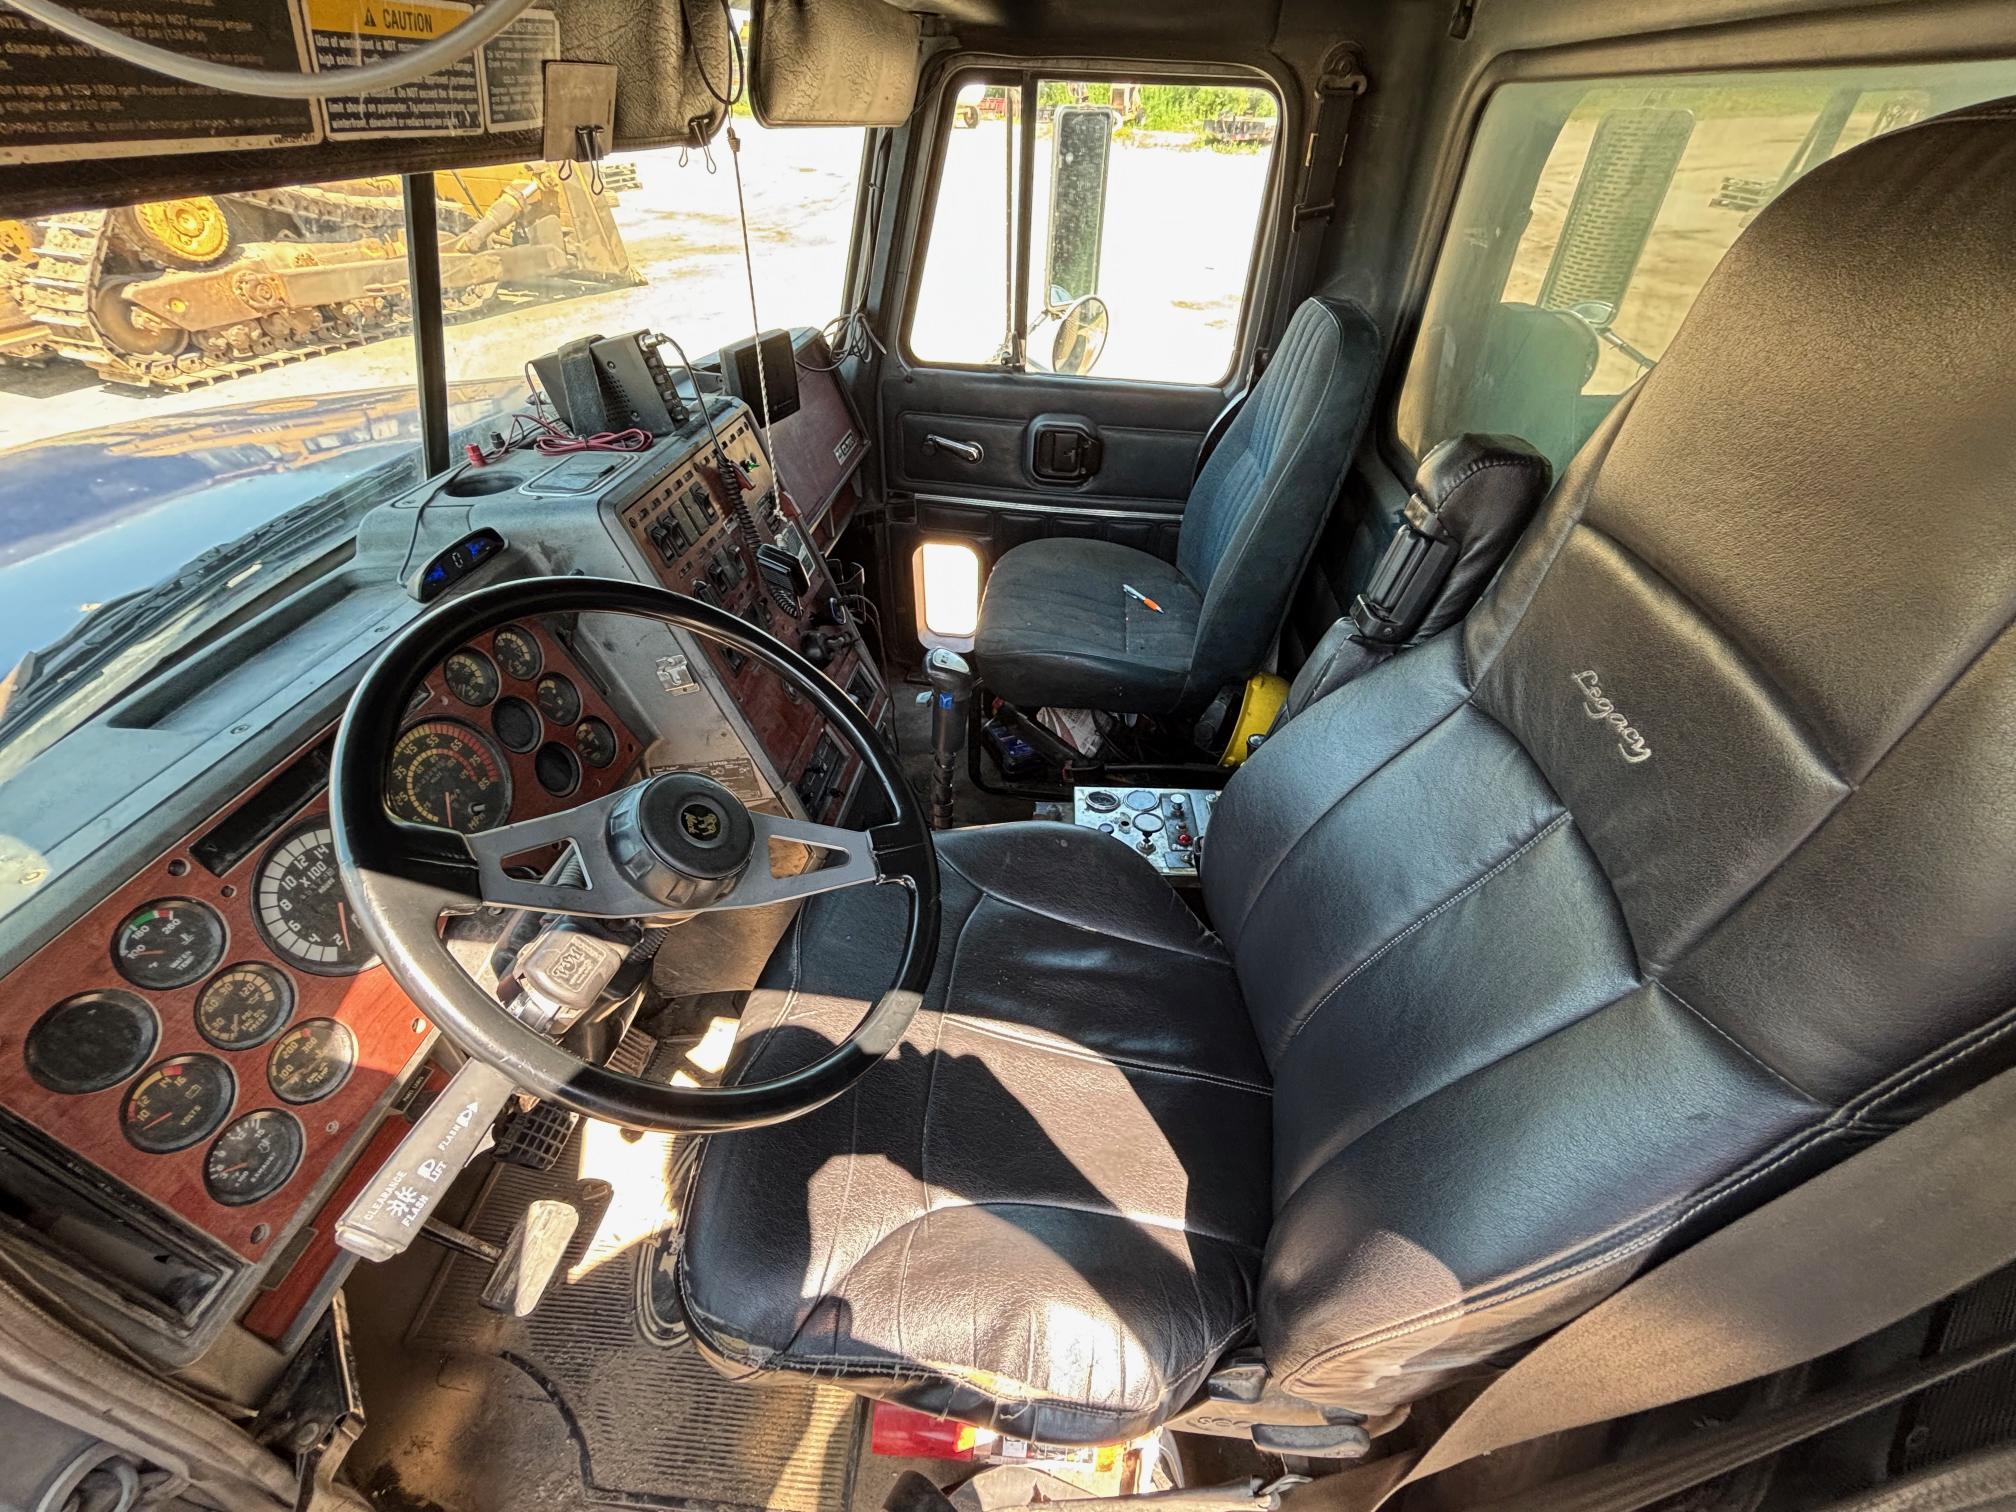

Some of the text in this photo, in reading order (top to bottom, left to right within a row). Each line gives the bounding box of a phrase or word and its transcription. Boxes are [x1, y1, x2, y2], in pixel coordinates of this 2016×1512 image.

[383, 8, 433, 33] CAUTION
[315, 34, 329, 47] Use
[330, 36, 339, 47] of
[383, 40, 396, 50] NOT
[318, 52, 335, 66] high
[1571, 670, 1652, 763] Legacy
[426, 734, 439, 747] 55
[450, 739, 463, 752] 65
[403, 743, 418, 755] 45
[469, 754, 481, 767] 75
[393, 765, 407, 780] 35
[478, 777, 490, 791] 85
[313, 844, 329, 859] 14
[294, 854, 309, 869] 12
[281, 875, 297, 890] 10
[279, 899, 293, 911] 8
[131, 925, 150, 940] 180
[162, 918, 181, 934] 260
[288, 920, 301, 932] 6
[308, 933, 321, 943] 4
[332, 933, 344, 946] 2
[127, 944, 146, 959] 100
[239, 982, 255, 997] 120
[282, 1041, 298, 1059] 200
[302, 1037, 317, 1054] 300
[279, 1064, 294, 1080] 100
[159, 1077, 172, 1088] 14
[174, 1076, 187, 1087] 16
[137, 1109, 150, 1121] 10
[180, 1105, 202, 1125] VOLTS
[438, 1124, 461, 1151] FLASH
[250, 1152, 276, 1183] EXHAUST
[429, 1160, 447, 1182] LIFT
[363, 1170, 408, 1221] CLEARANCE
[401, 1195, 429, 1227] FLASH
